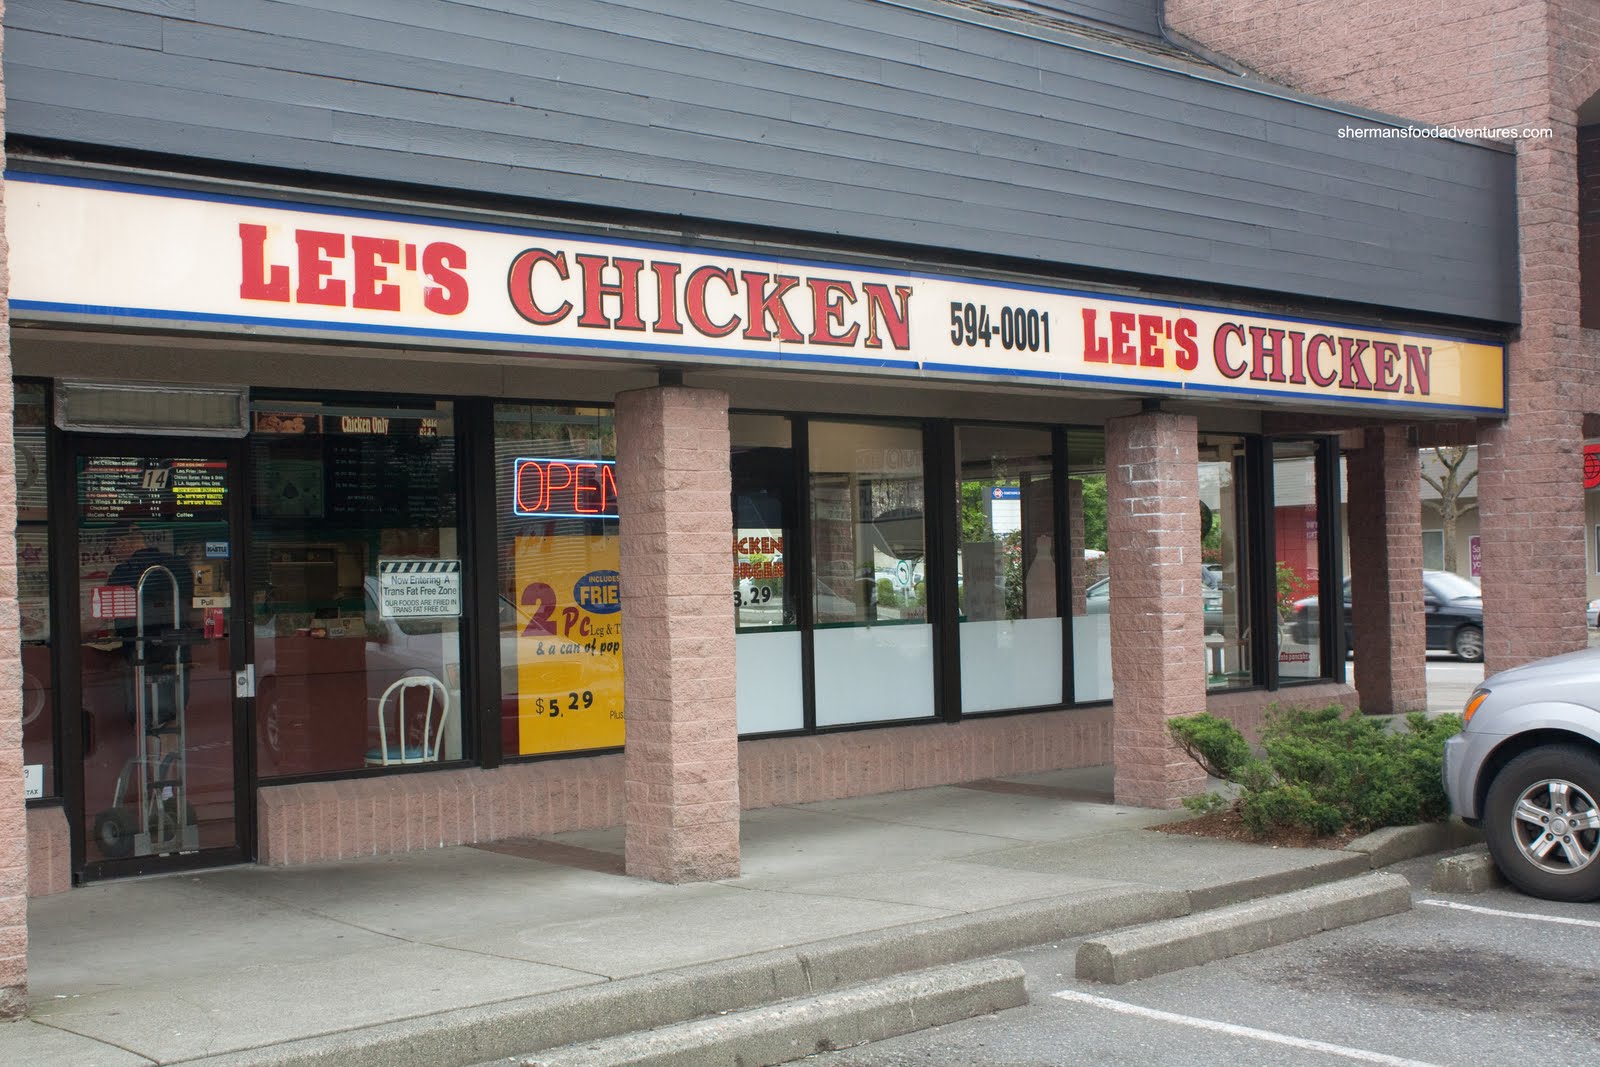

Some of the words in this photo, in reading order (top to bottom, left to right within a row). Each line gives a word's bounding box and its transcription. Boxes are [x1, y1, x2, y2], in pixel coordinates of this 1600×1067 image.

[239, 223, 469, 315] LEE'S
[507, 247, 913, 351] CHICKEN
[950, 301, 1050, 353] 594-0001
[1082, 308, 1199, 371] LEE'S
[1213, 322, 1432, 396] CHICKEN
[341, 416, 370, 433] Chicken
[372, 417, 389, 435] Only
[147, 470, 166, 487] 14
[392, 576, 408, 585] Now
[410, 576, 441, 586] Entering
[444, 576, 450, 584] A
[384, 587, 404, 596] Trans
[406, 587, 418, 596] Fat
[420, 586, 436, 596] Free
[438, 586, 456, 595] Zone
[580, 585, 619, 605] FRIE
[521, 582, 557, 637] 2
[590, 624, 604, 637] Leg
[606, 624, 612, 634] &
[536, 641, 544, 655] &
[549, 644, 556, 655] a
[560, 644, 580, 655] can
[584, 638, 596, 656] of
[600, 641, 620, 656] pop
[610, 711, 624, 720] Plus
